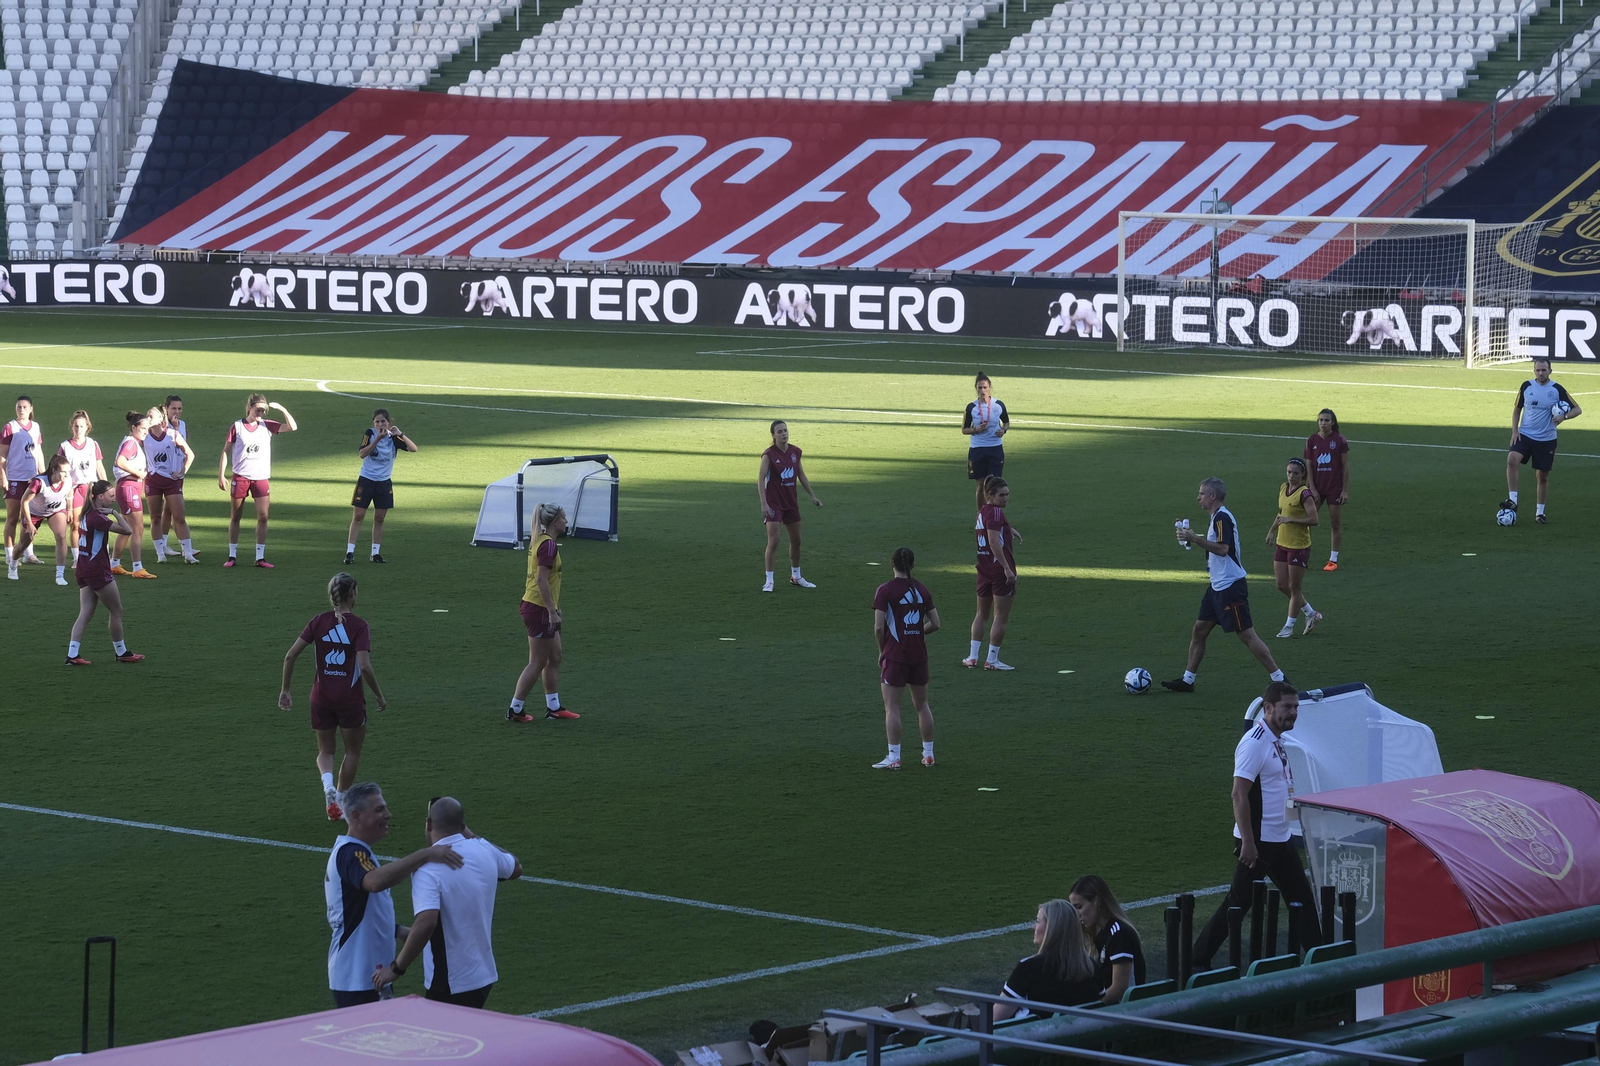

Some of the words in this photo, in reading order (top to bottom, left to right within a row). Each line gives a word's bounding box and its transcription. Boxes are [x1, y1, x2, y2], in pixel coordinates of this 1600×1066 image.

[160, 131, 792, 262] VAMOS
[685, 114, 1428, 279] ESPAÑA
[0, 263, 165, 304] TERO
